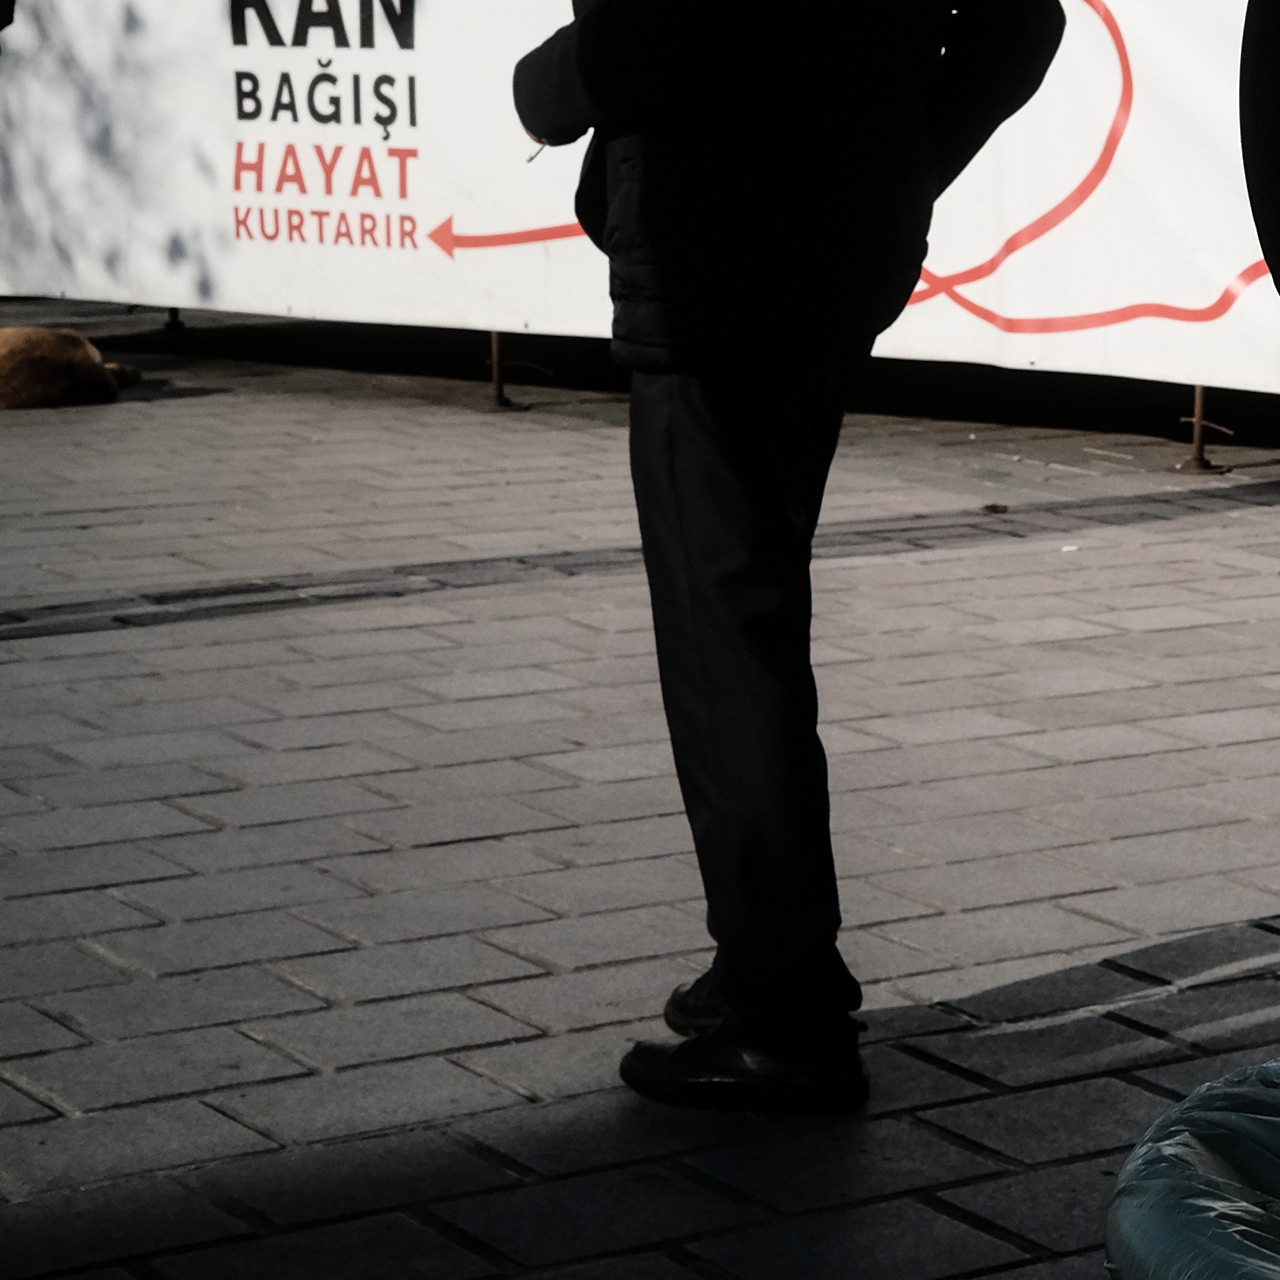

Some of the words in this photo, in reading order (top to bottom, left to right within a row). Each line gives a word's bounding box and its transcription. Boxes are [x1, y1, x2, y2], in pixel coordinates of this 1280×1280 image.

[235, 58, 417, 141] BAĞIŞI
[233, 141, 419, 200] HAYAT
[233, 206, 419, 250] KURTARIR
